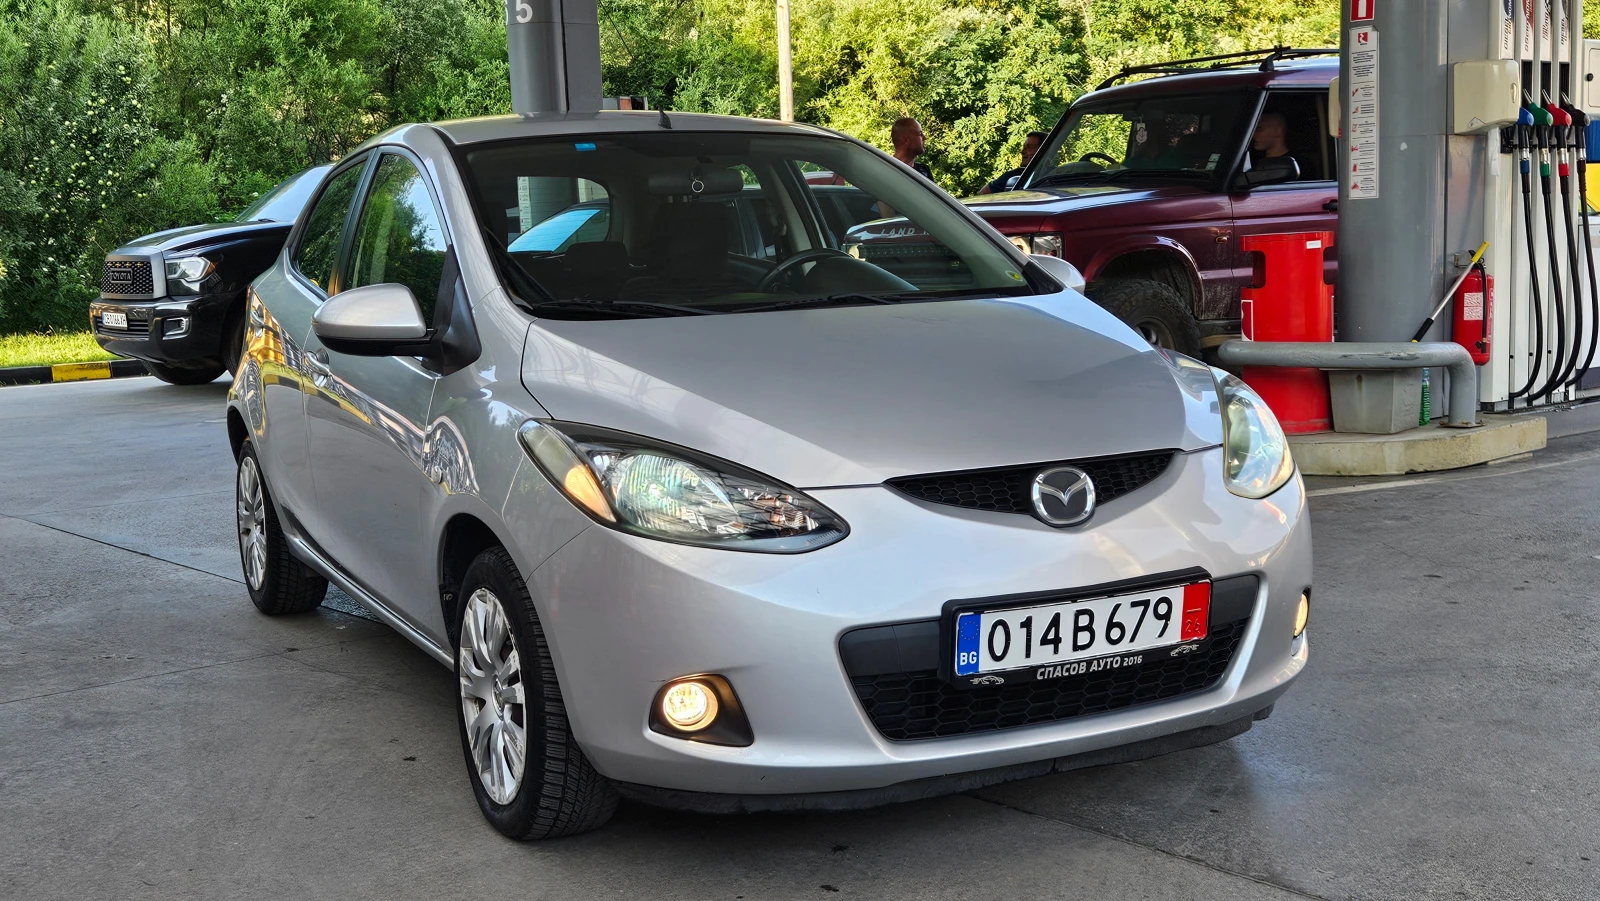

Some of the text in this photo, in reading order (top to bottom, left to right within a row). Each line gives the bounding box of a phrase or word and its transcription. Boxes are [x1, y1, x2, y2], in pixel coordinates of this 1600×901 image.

[516, 0, 533, 24] 5
[881, 227, 916, 237] LAND
[110, 272, 131, 280] TOYOTA
[960, 650, 978, 666] BG
[1036, 654, 1143, 681] СПАСОВ АУТО 2016
